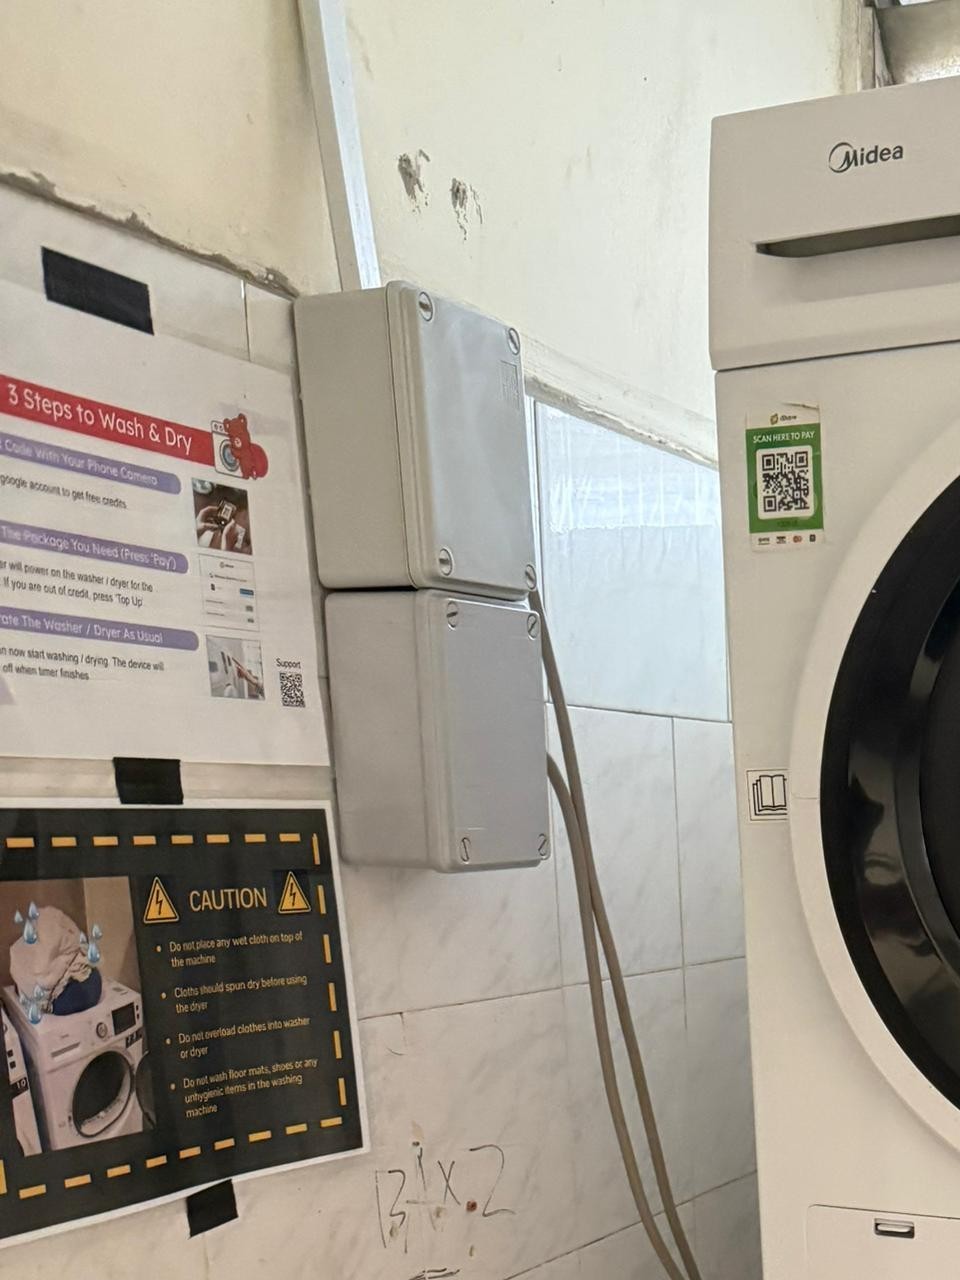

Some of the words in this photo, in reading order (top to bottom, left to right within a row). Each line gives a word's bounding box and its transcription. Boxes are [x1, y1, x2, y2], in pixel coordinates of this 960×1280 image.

[829, 142, 903, 173] Midea
[7, 383, 19, 405] 3
[23, 388, 72, 422] Steps
[76, 404, 94, 425] to
[98, 408, 144, 438] Wash
[149, 423, 160, 443] &
[164, 427, 192, 455] Dry
[753, 434, 772, 443] SCAN
[772, 433, 790, 441] HERE
[791, 431, 800, 440] TO
[801, 431, 815, 439] PAY
[62, 453, 84, 468] Your
[88, 459, 118, 477] Phone
[120, 466, 158, 485] Camera
[94, 624, 121, 640] Dryer
[123, 628, 135, 641] As
[189, 887, 267, 912] CAUTION
[169, 941, 181, 952] Do
[216, 937, 230, 948] any
[280, 933, 293, 944] top
[247, 979, 260, 990] dry
[178, 1032, 191, 1044] Do
[183, 1078, 195, 1089] Do
